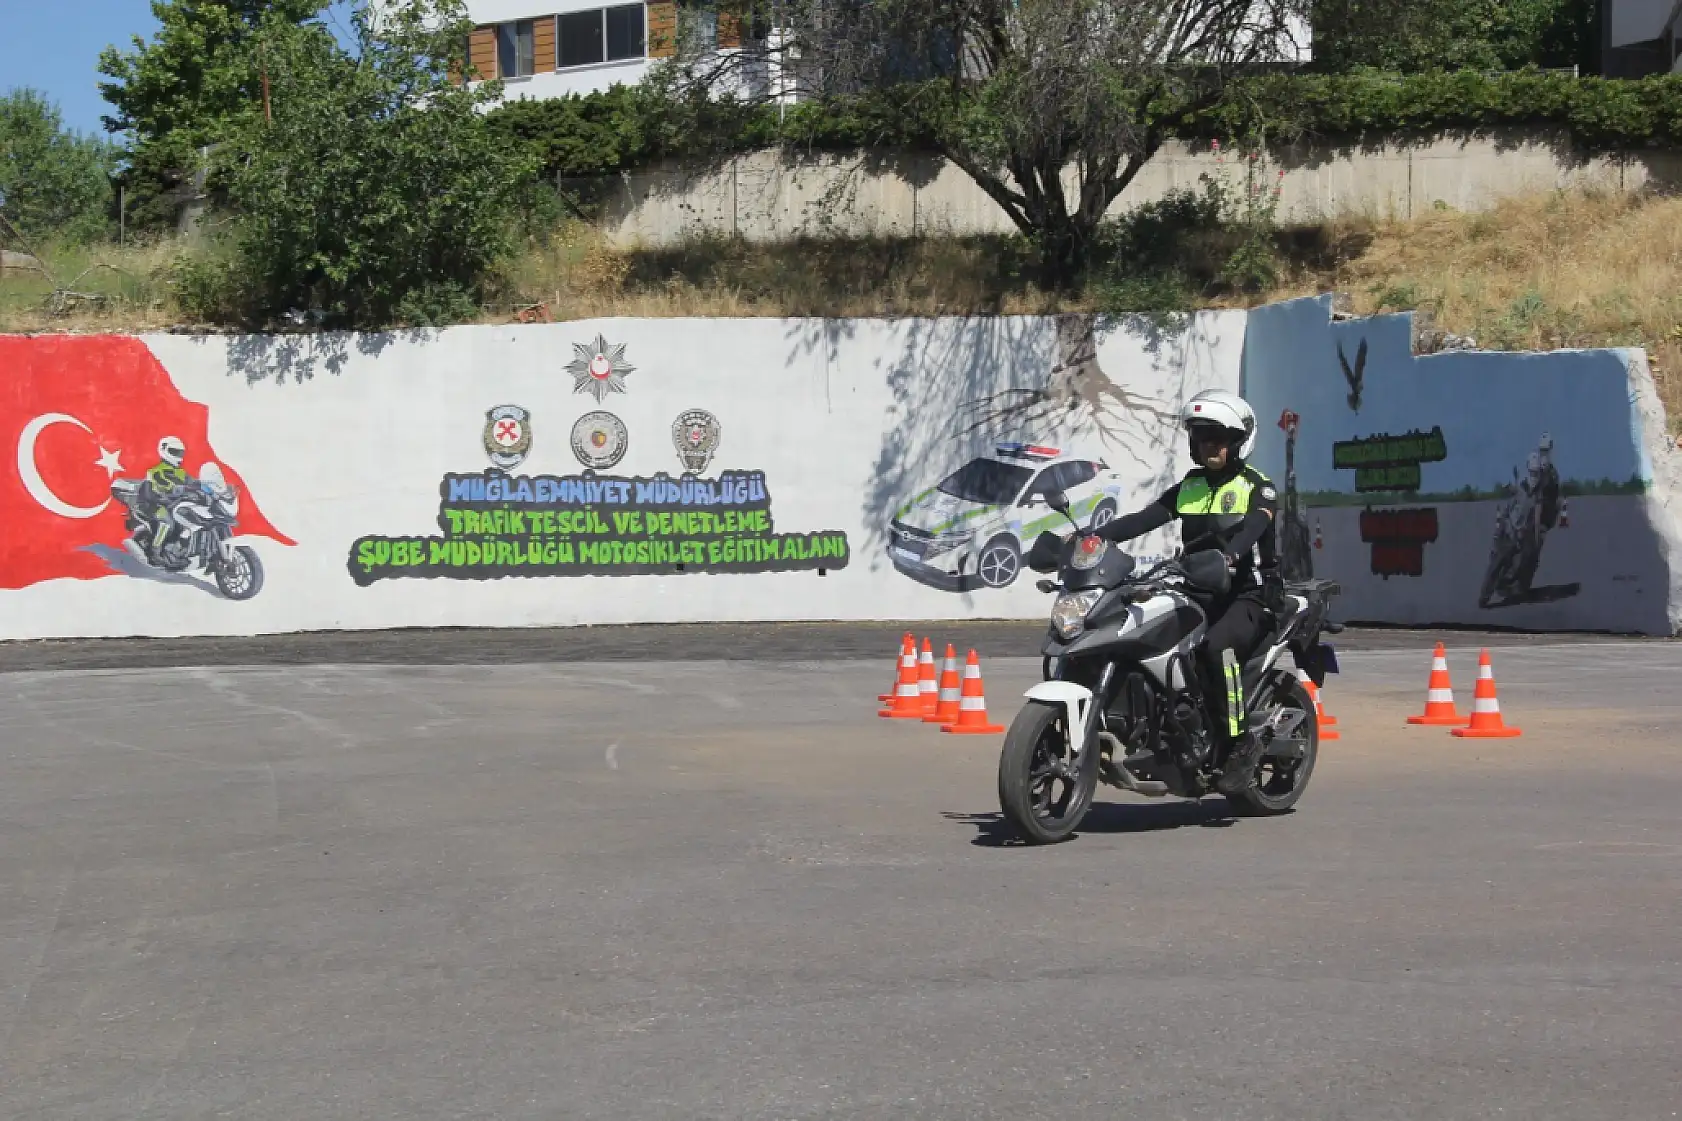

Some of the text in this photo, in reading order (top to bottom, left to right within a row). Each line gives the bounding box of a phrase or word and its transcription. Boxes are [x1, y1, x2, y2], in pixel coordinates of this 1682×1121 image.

[449, 473, 766, 505] MUĞLA EMNİYET MÜDÜRLÜĞÜ
[444, 503, 770, 535] TRAFİK TESCİL VE DENETLEME
[357, 532, 846, 573] ŞUBE MÜDÜRLÜĞÜ MOTOSİKLET EĞİTİM ALANI
